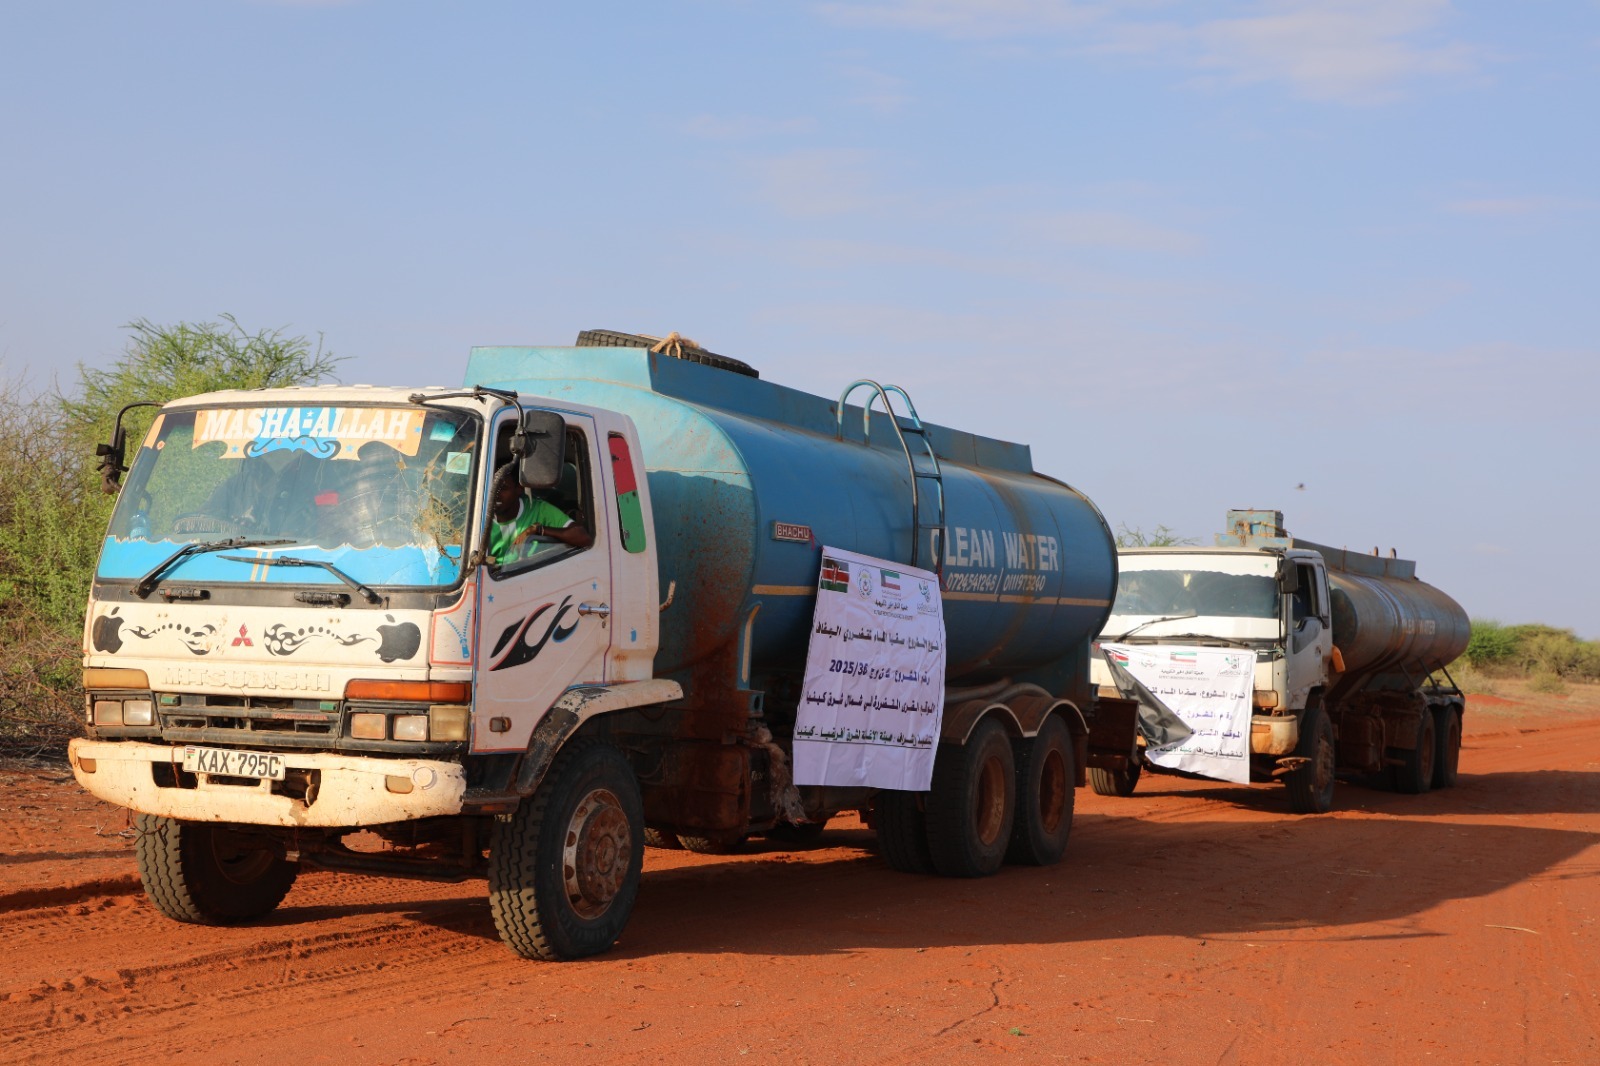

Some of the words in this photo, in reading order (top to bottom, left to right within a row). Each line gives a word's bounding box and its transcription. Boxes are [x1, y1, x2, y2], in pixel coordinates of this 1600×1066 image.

[777, 525, 810, 539] BHACHU
[930, 526, 995, 568] CLEAN
[1003, 531, 1059, 571] WATER
[161, 667, 332, 692] MITSUBISHI
[828, 659, 869, 677] 2025/36
[197, 749, 230, 774] KAX
[237, 753, 279, 778] 795C
